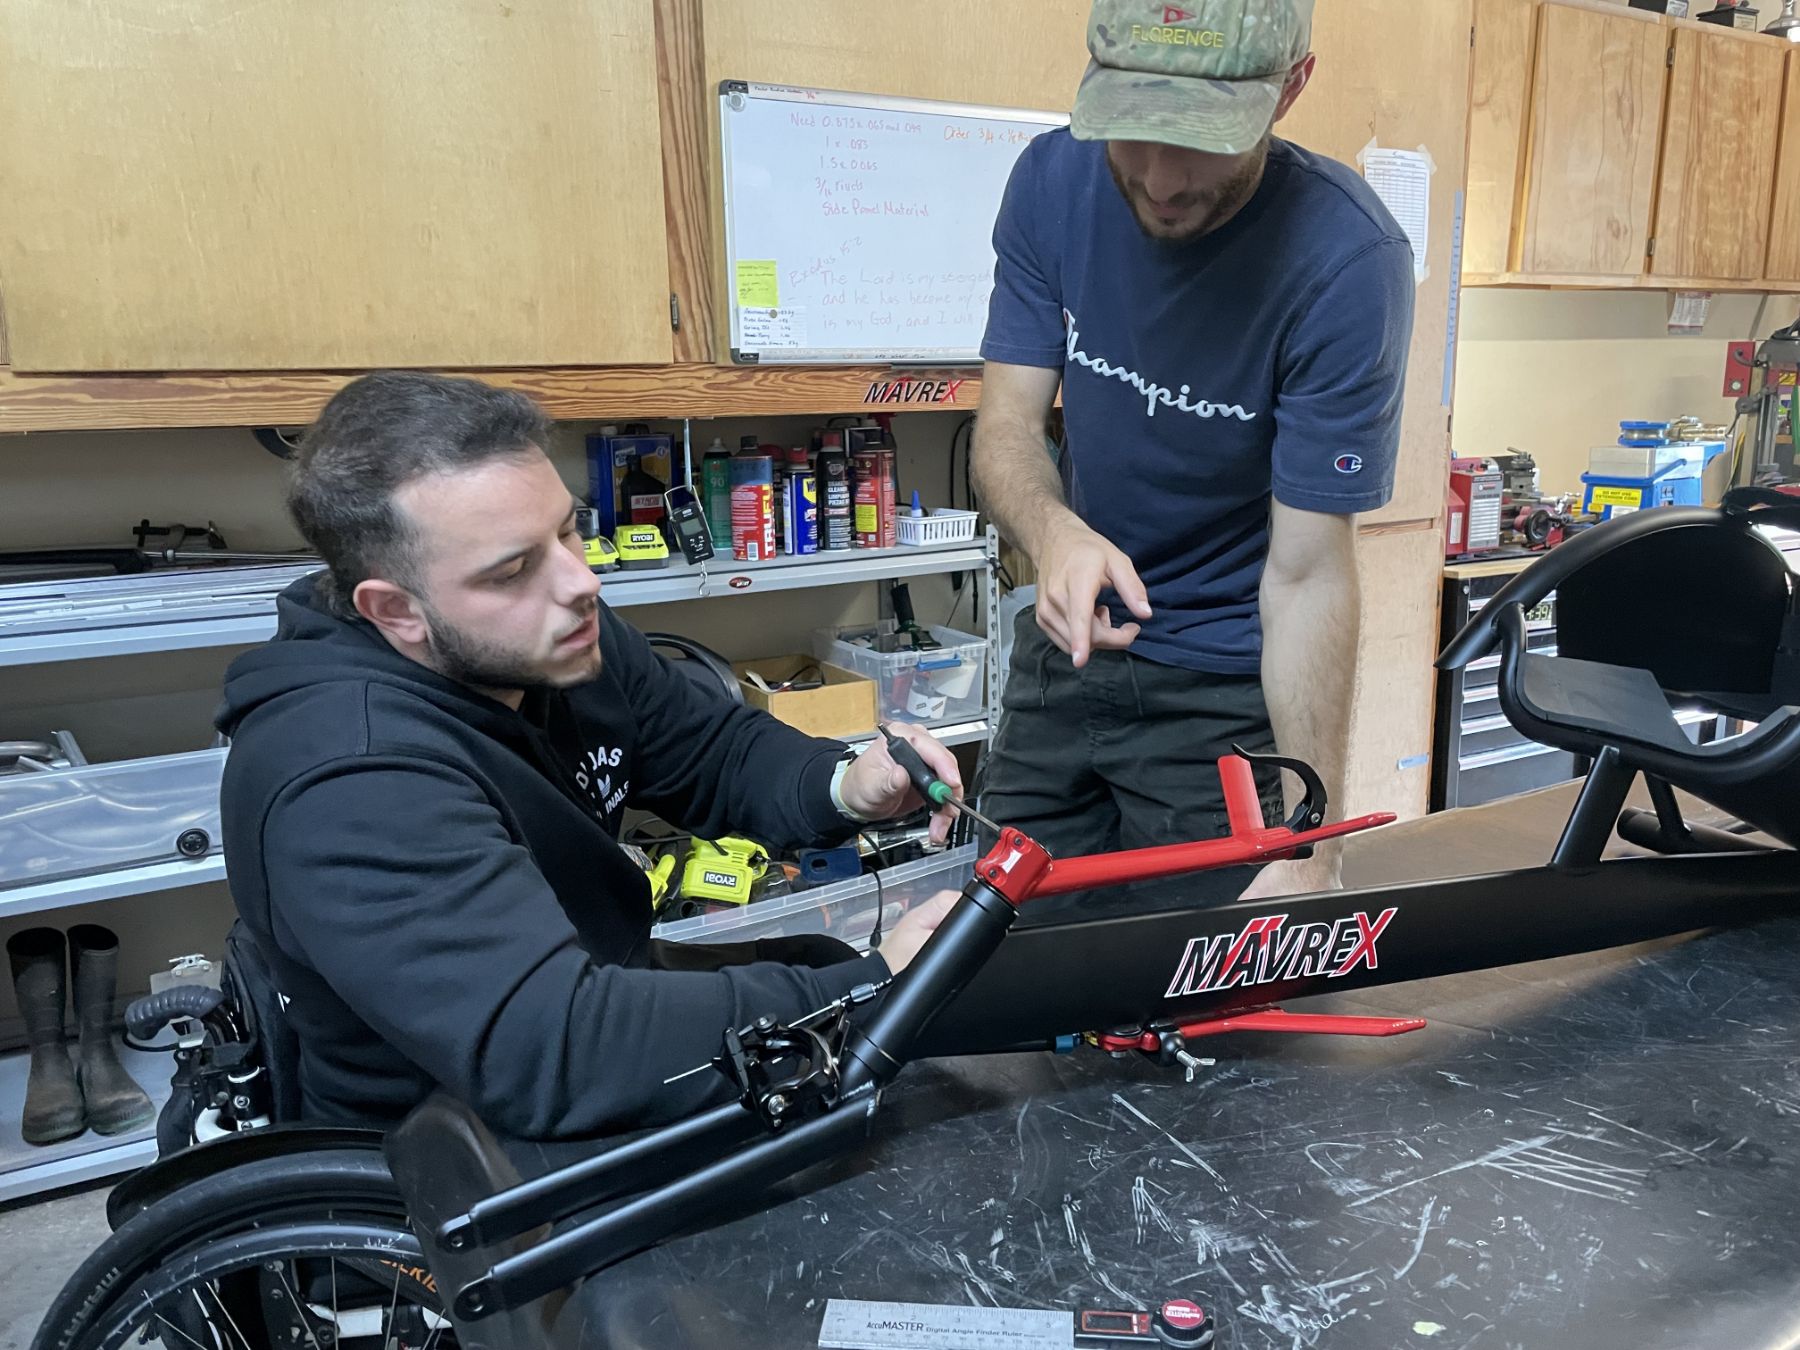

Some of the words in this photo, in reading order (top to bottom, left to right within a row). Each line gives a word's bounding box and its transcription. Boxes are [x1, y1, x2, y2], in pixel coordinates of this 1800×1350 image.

[1131, 25, 1225, 48] FLORENCE
[823, 201, 849, 216] Side
[884, 201, 929, 217] Material
[821, 270, 847, 286] The
[860, 268, 894, 284] Lord
[902, 273, 914, 284] is
[918, 273, 933, 286] my
[822, 290, 846, 305] and
[854, 290, 869, 304] he
[880, 290, 899, 304] has
[910, 290, 951, 304] become
[958, 295, 972, 308] my
[846, 318, 863, 330] my
[906, 316, 929, 327] and
[863, 377, 964, 404] MAVREX
[632, 534, 653, 542] RYOBI
[705, 871, 737, 887] RYOBI
[1163, 907, 1399, 998] MAVREX
[866, 1321, 924, 1332] AccuMASTER
